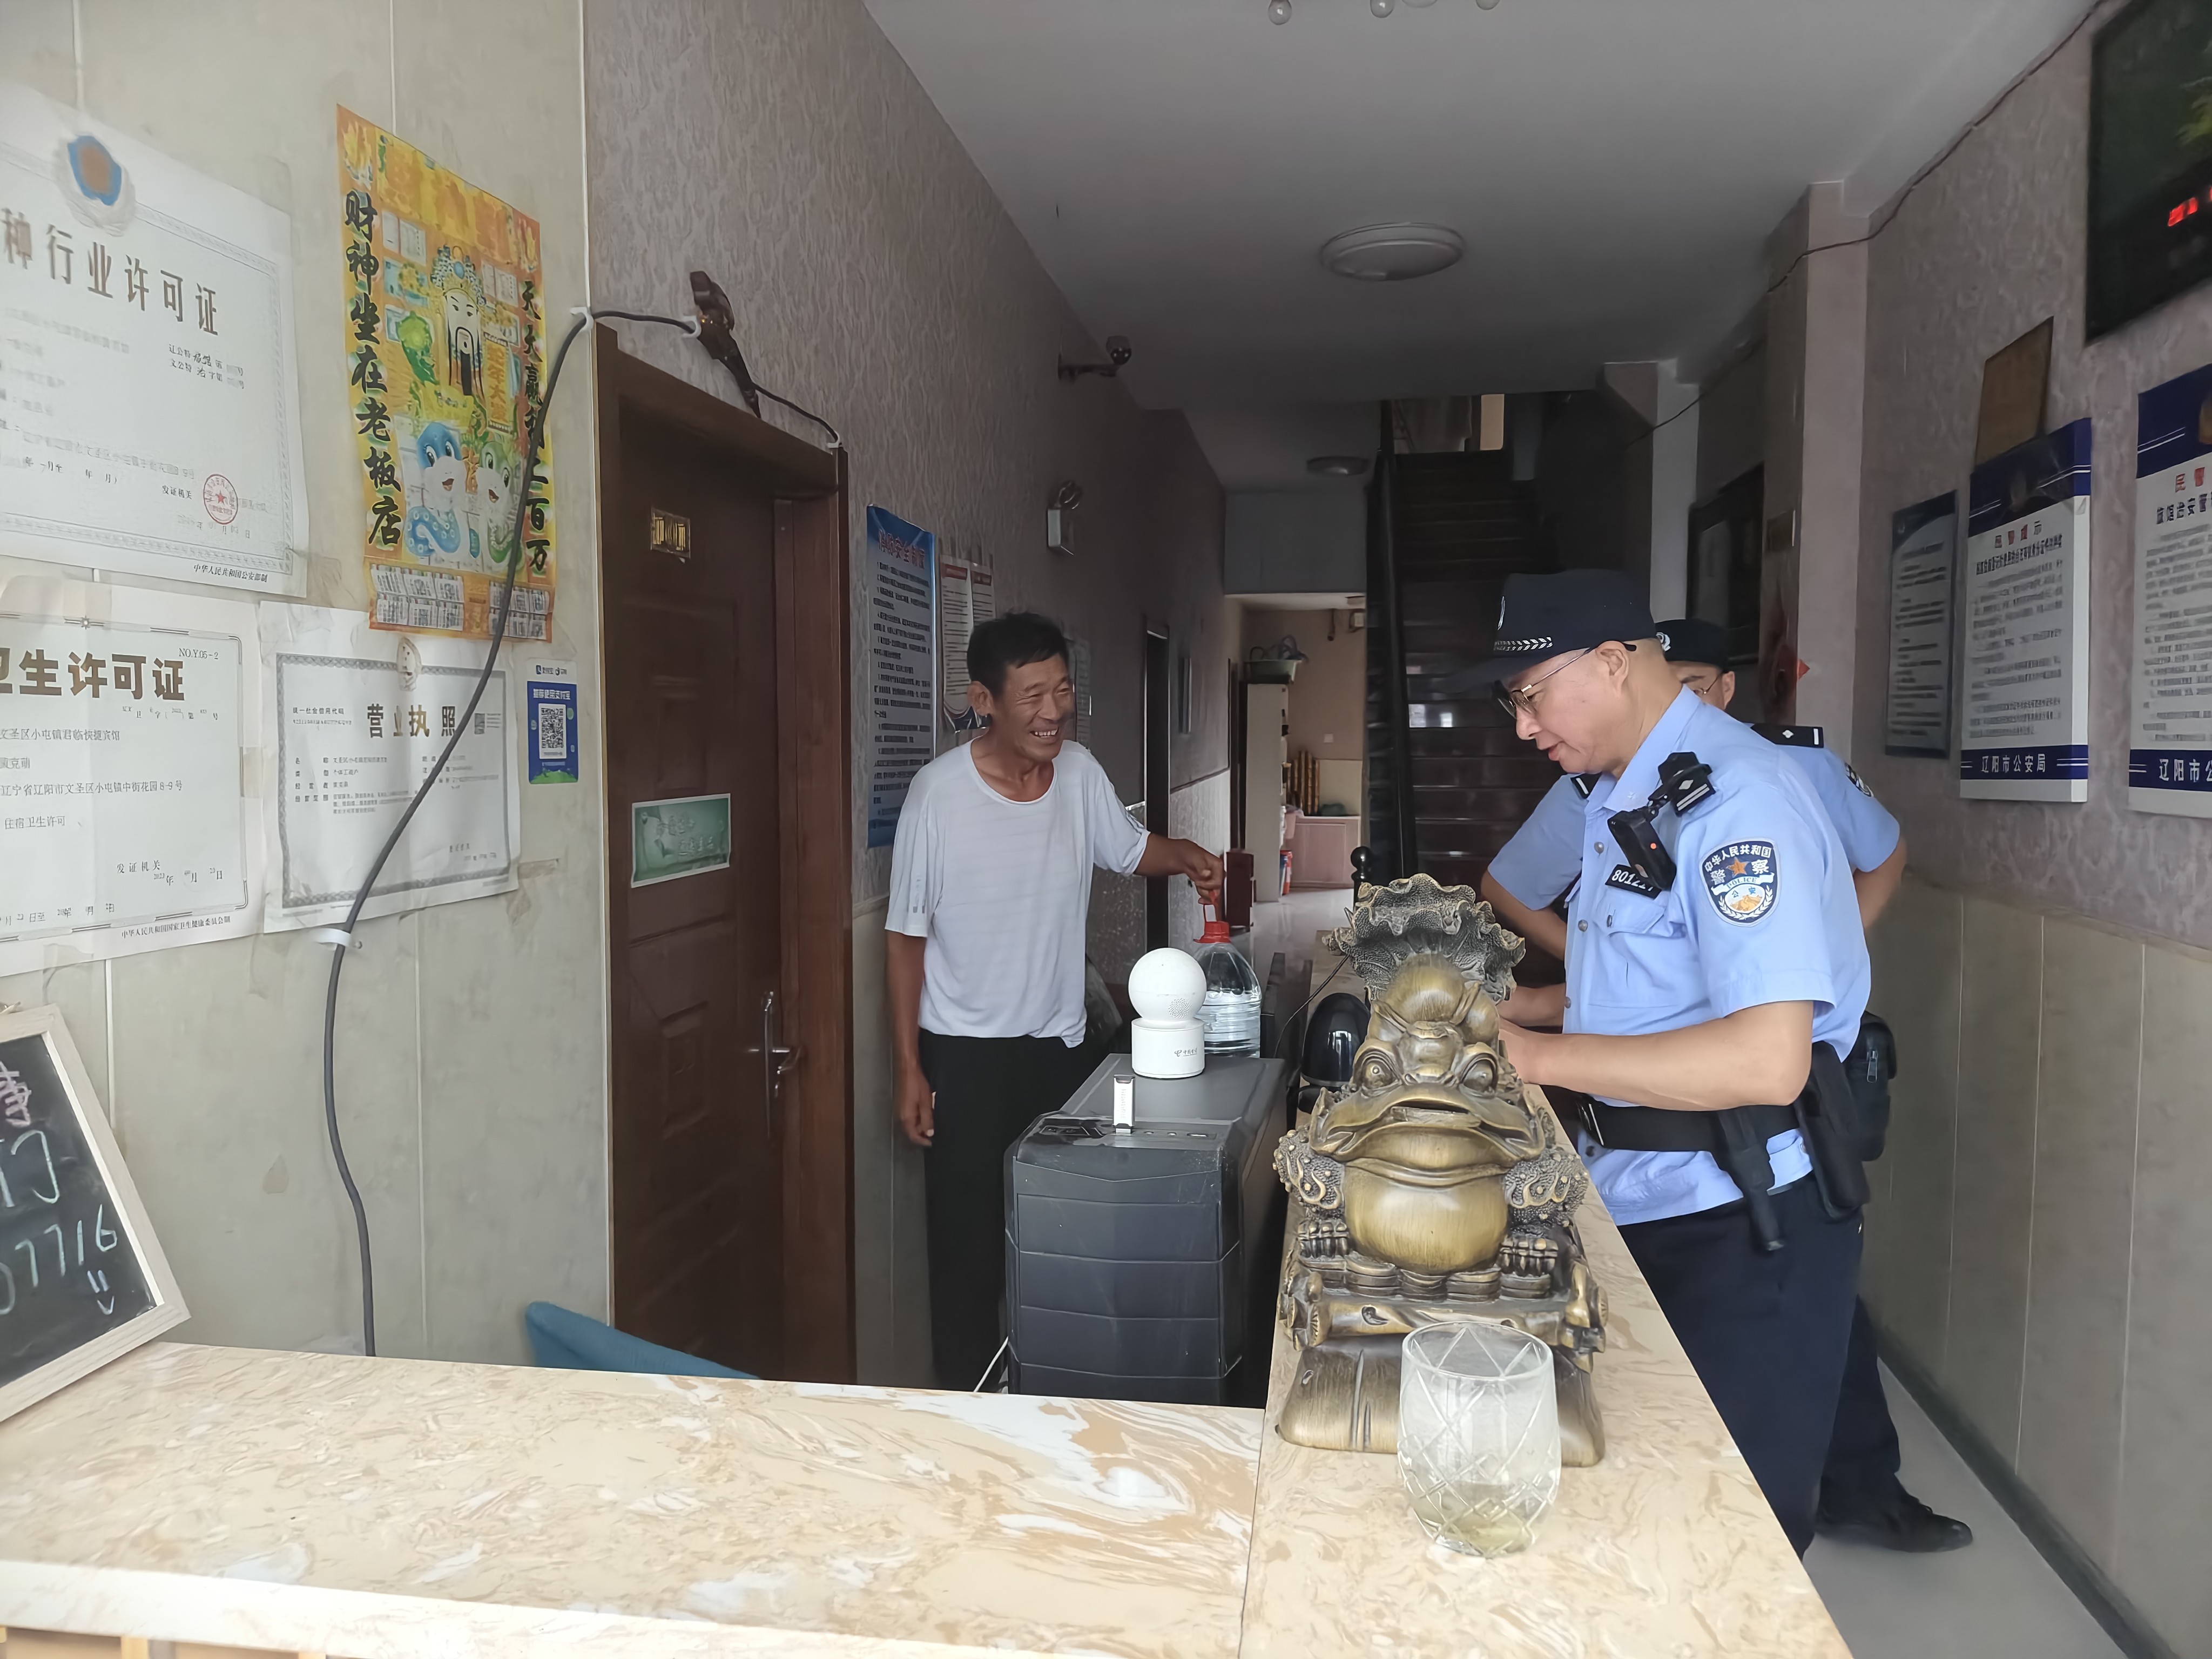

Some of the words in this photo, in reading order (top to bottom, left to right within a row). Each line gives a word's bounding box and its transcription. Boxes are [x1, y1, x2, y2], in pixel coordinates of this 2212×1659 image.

[345, 189, 402, 545] 财神坐在老板店
[367, 703, 456, 738] 营业执照
[1981, 753, 2046, 773] 辽阳市公安局
[1704, 844, 1771, 872] 中华人民共和国
[1727, 877, 1757, 889] POLICE
